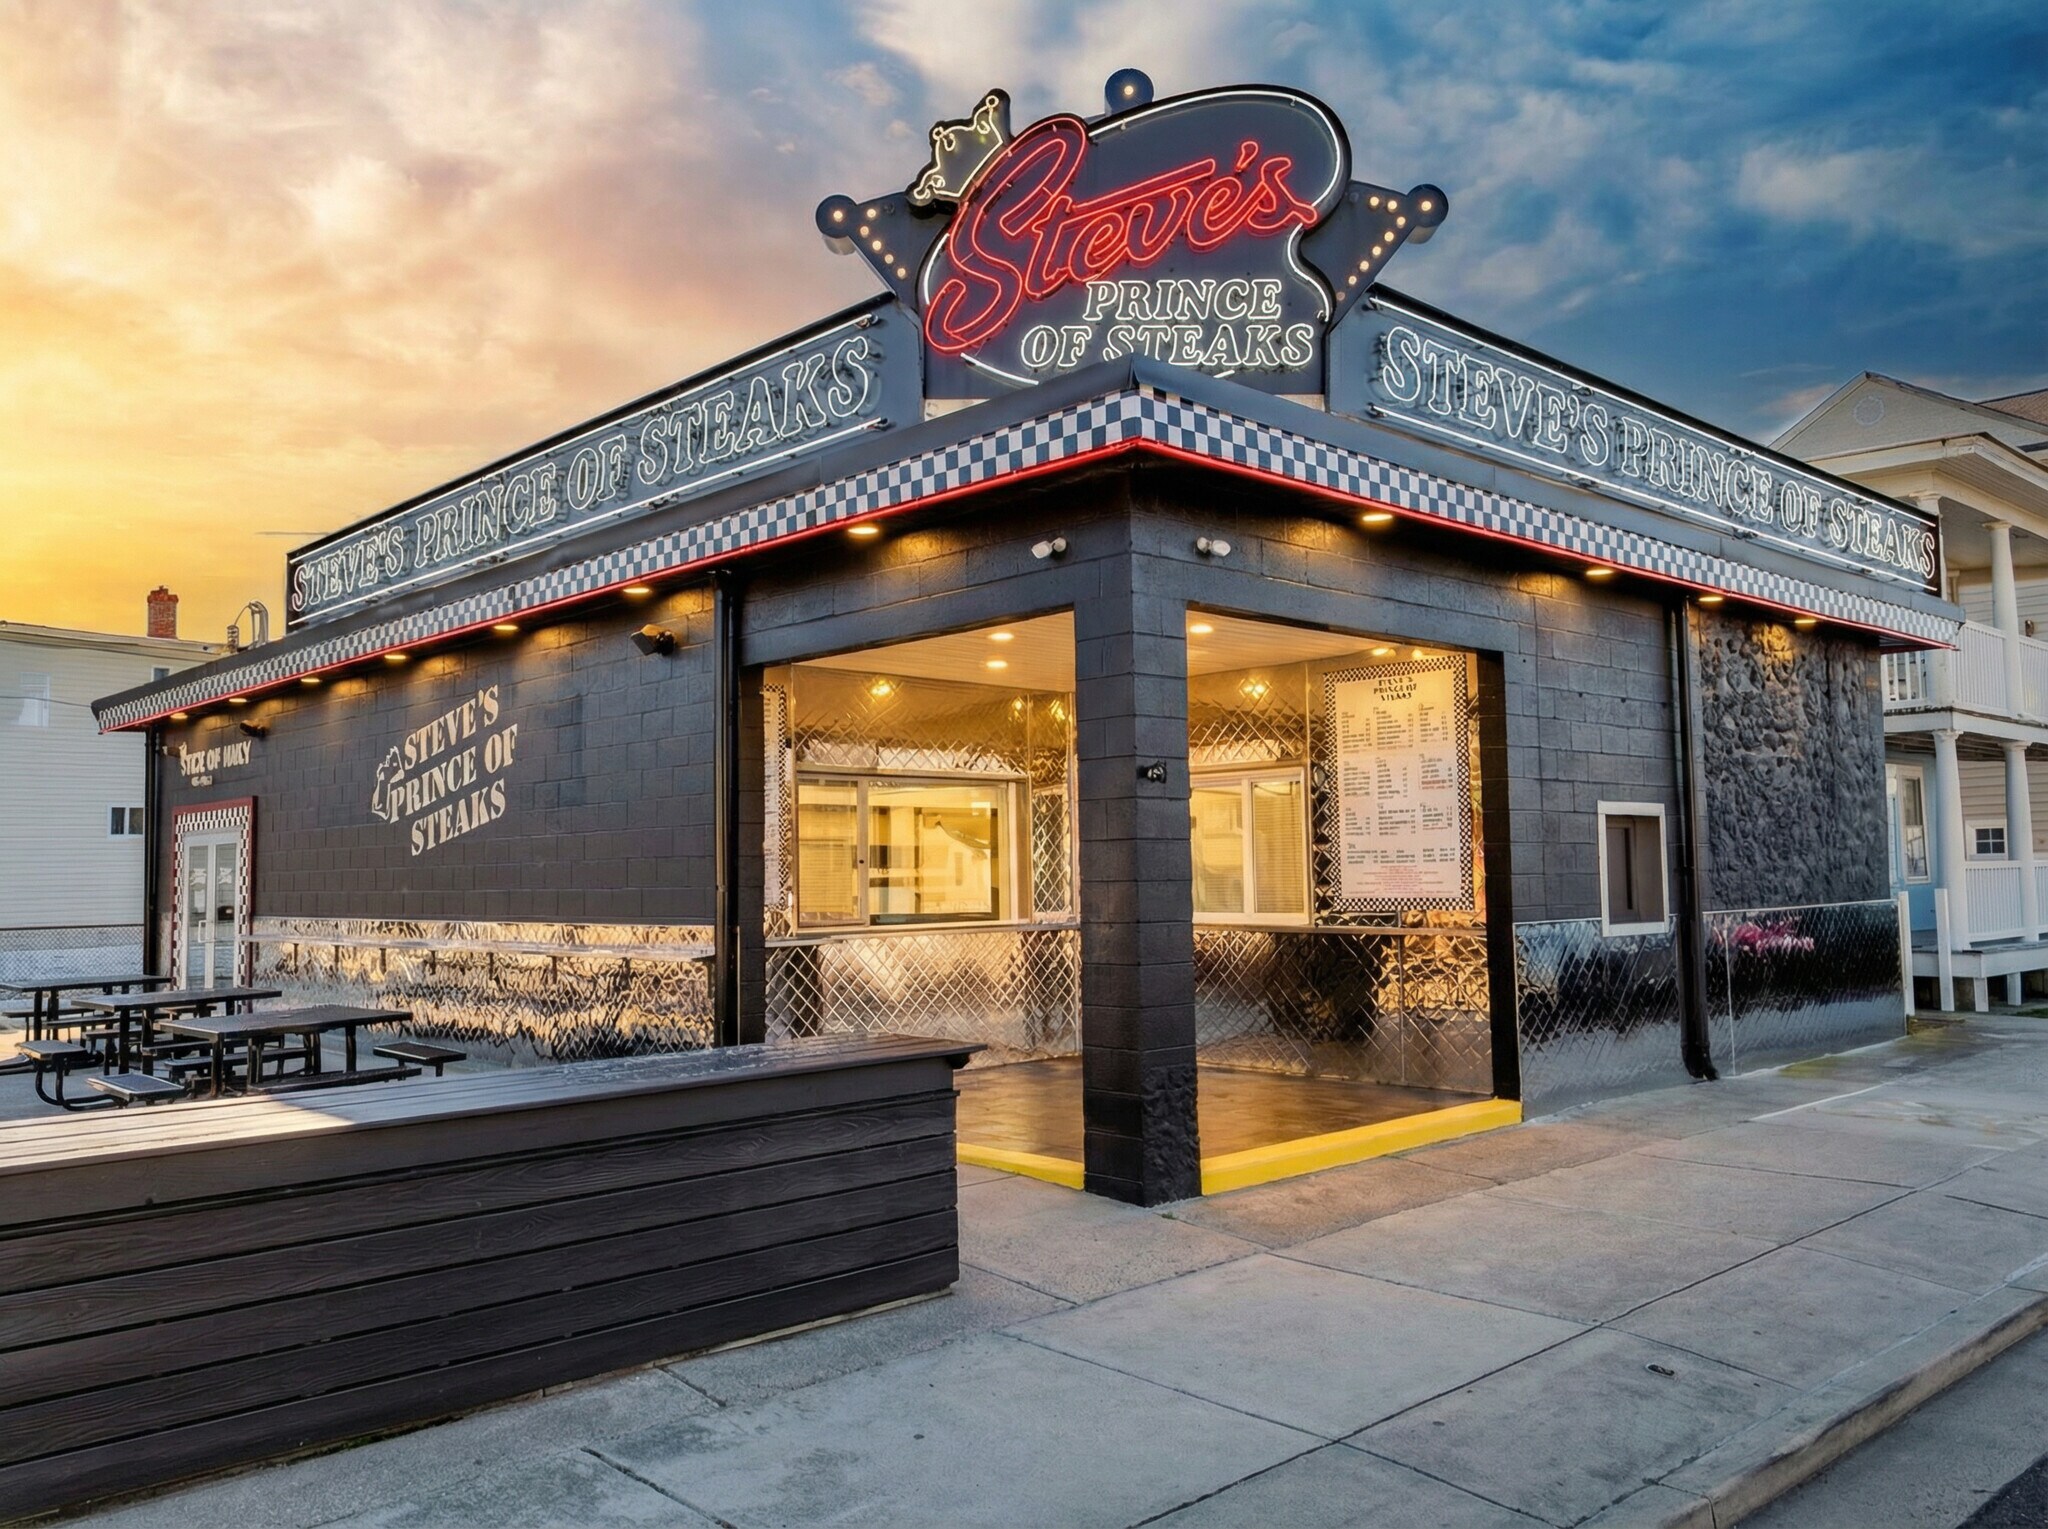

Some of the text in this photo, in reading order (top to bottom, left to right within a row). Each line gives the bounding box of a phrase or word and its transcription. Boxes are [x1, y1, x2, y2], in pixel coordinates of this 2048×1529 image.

[925, 116, 1318, 353] Steve's
[1020, 324, 1314, 368] OF STEAKS
[1082, 278, 1283, 322] PRINCE
[291, 335, 869, 612] STEVE'S PRINCE OF STEAKS
[1382, 326, 1936, 580] STEVE'S PRINCE OF STEAKS
[389, 723, 518, 825] PRINCE OF
[404, 684, 499, 771] STEVE'S
[411, 777, 506, 857] STEAKS
